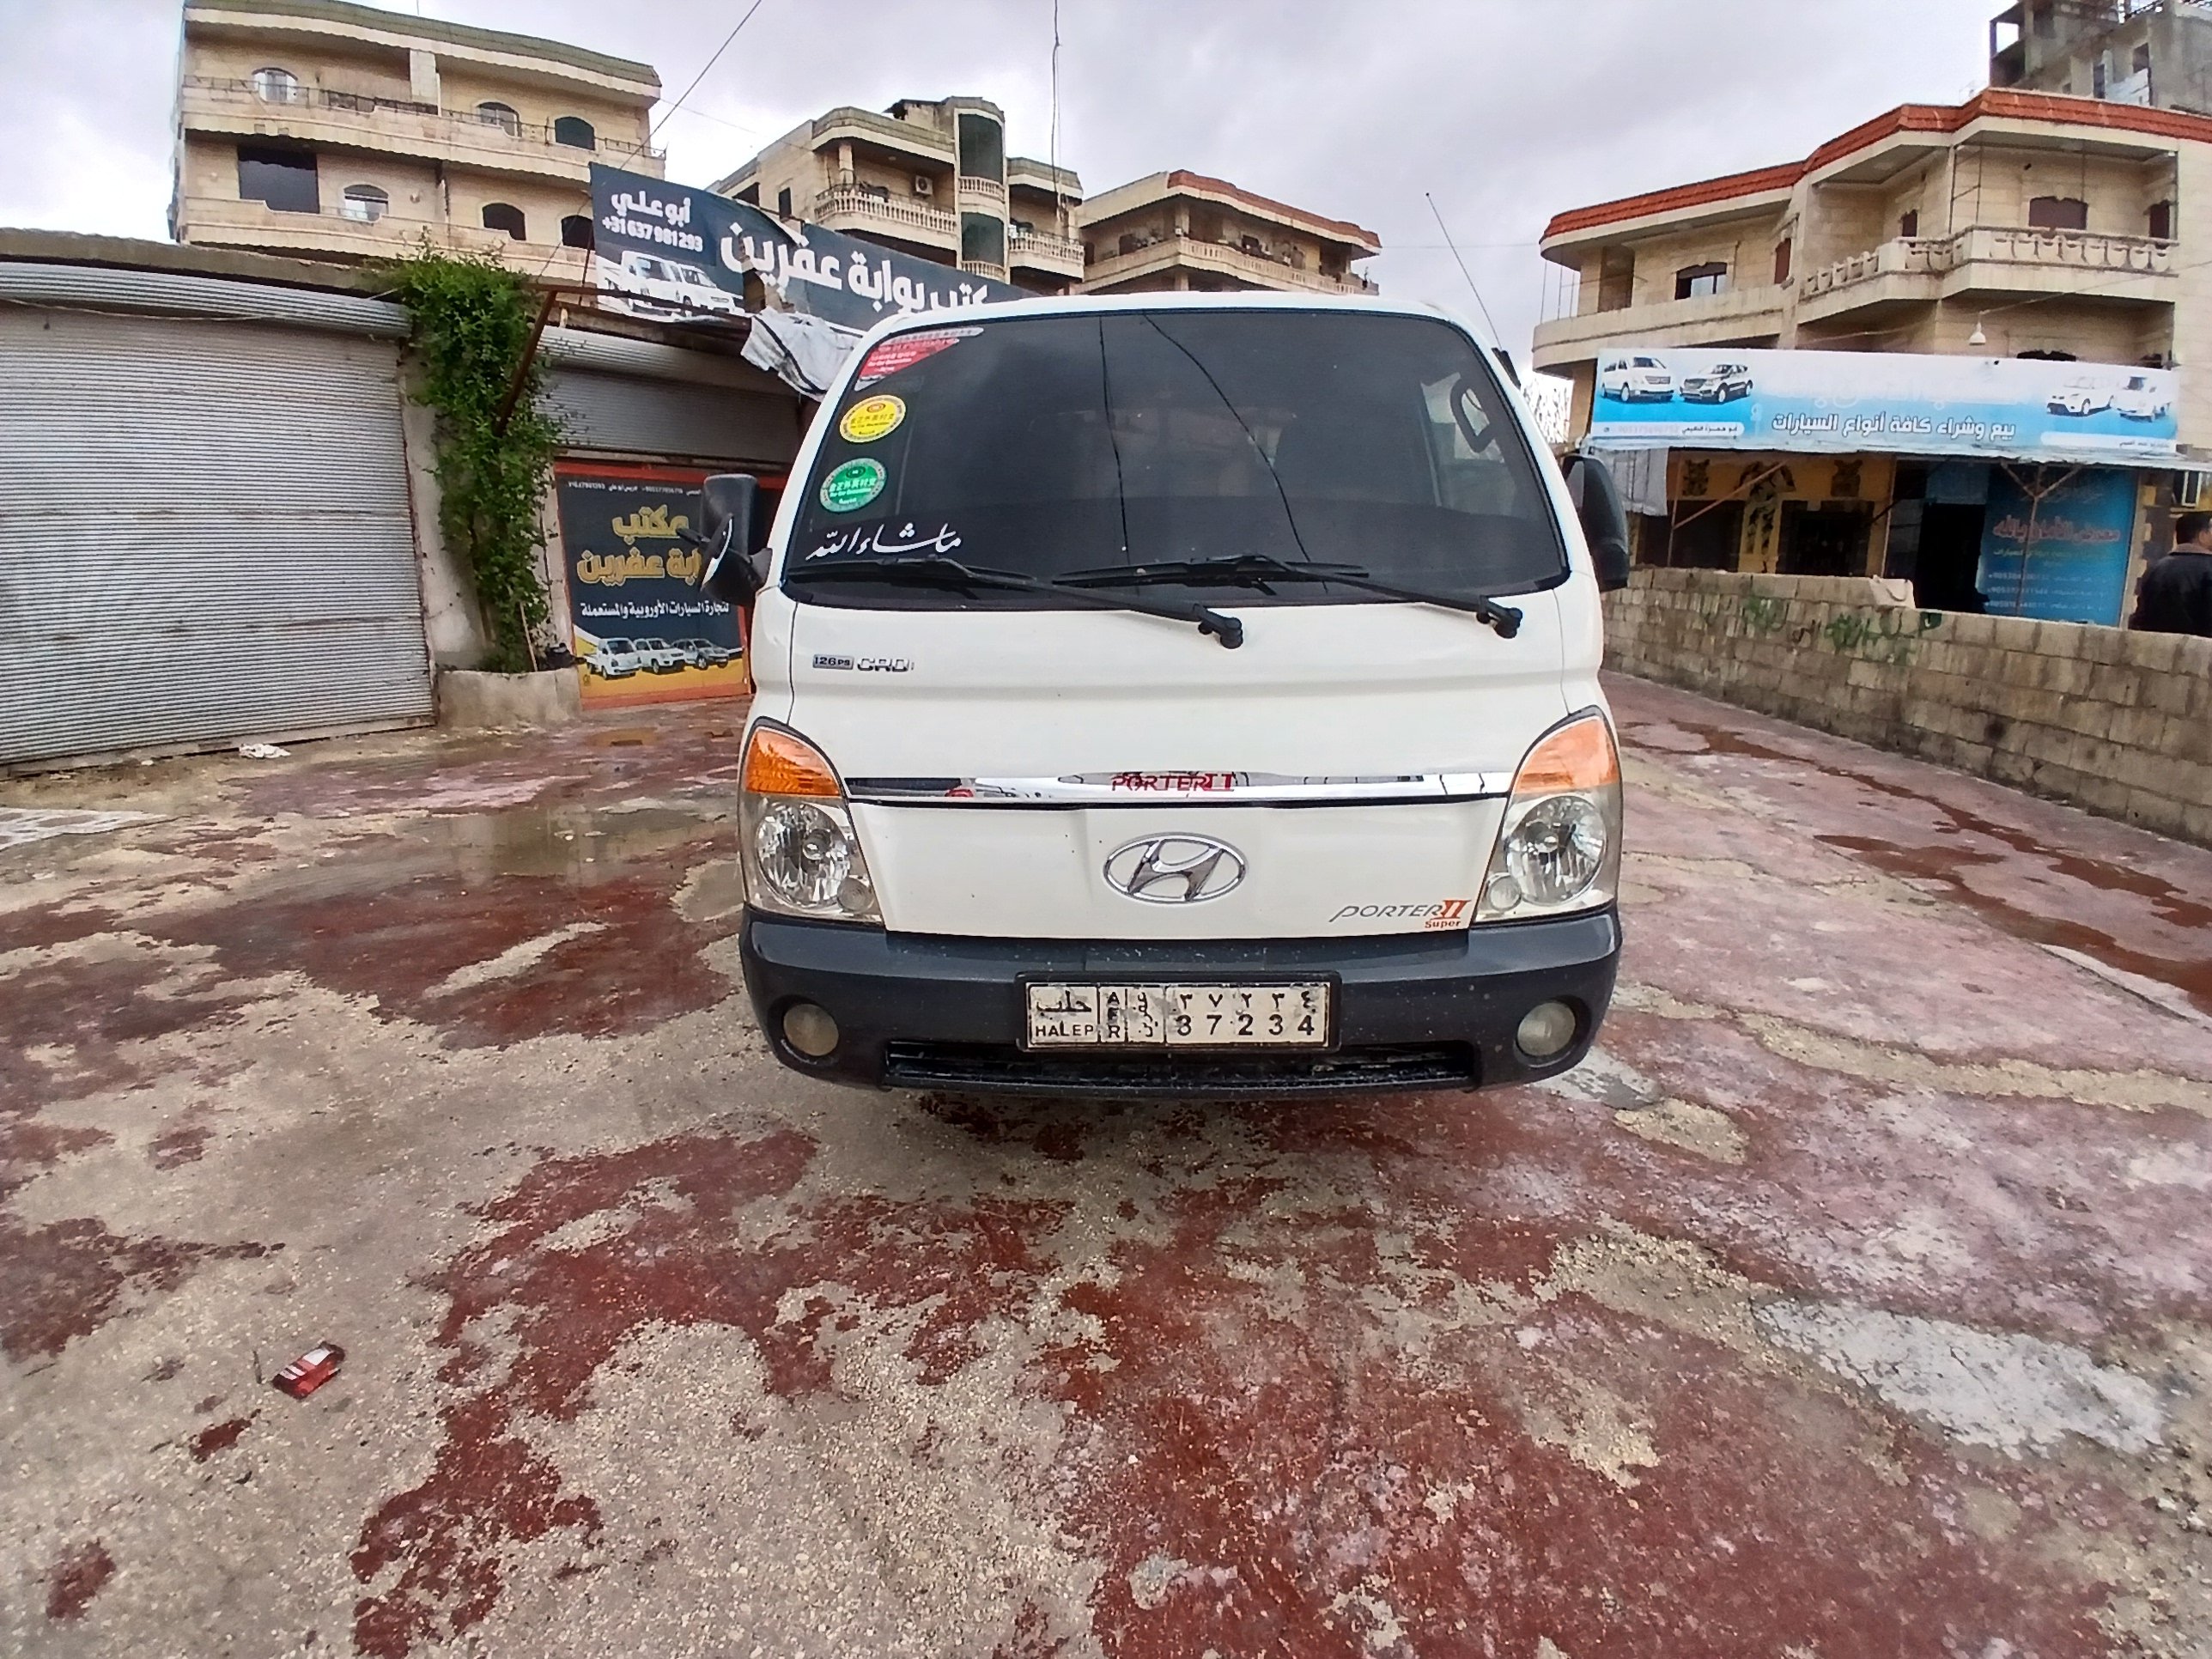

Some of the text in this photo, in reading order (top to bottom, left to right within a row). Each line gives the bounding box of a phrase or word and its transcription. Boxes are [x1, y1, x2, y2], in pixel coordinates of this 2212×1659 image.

[611, 191, 663, 217] علي
[720, 222, 842, 290] عفرين
[848, 250, 925, 314] بوابة
[1771, 410, 2015, 441] بيع وشراء كافة أنواع السيارات
[577, 547, 665, 586] عفرين
[669, 600, 704, 617] السيارات
[705, 599, 729, 617] لتجارة
[1036, 990, 1092, 1017] حلب
[1036, 1020, 1094, 1038] HALEP
